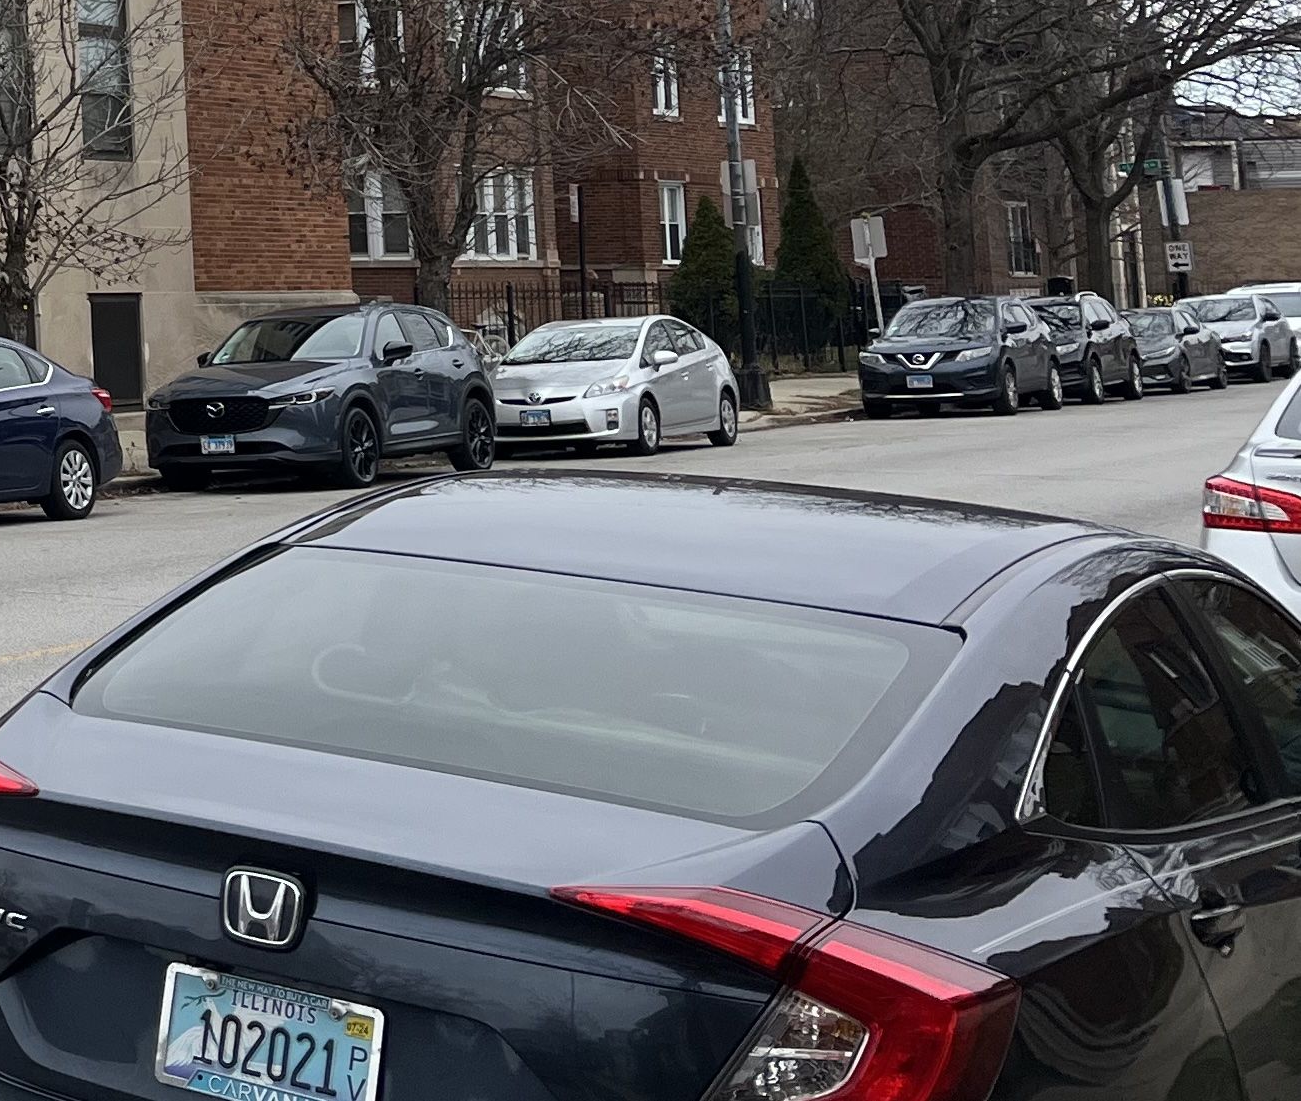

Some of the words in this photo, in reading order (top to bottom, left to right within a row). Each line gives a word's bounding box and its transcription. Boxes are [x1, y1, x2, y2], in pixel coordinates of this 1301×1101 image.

[1168, 244, 1188, 252] ONE
[221, 976, 235, 986] THE
[237, 979, 255, 990] NEW
[258, 984, 274, 995] WAY
[274, 987, 285, 997] TO
[310, 996, 328, 1008] CAR
[231, 990, 317, 1024] ILLINOIS
[193, 1009, 337, 1096] 102021
